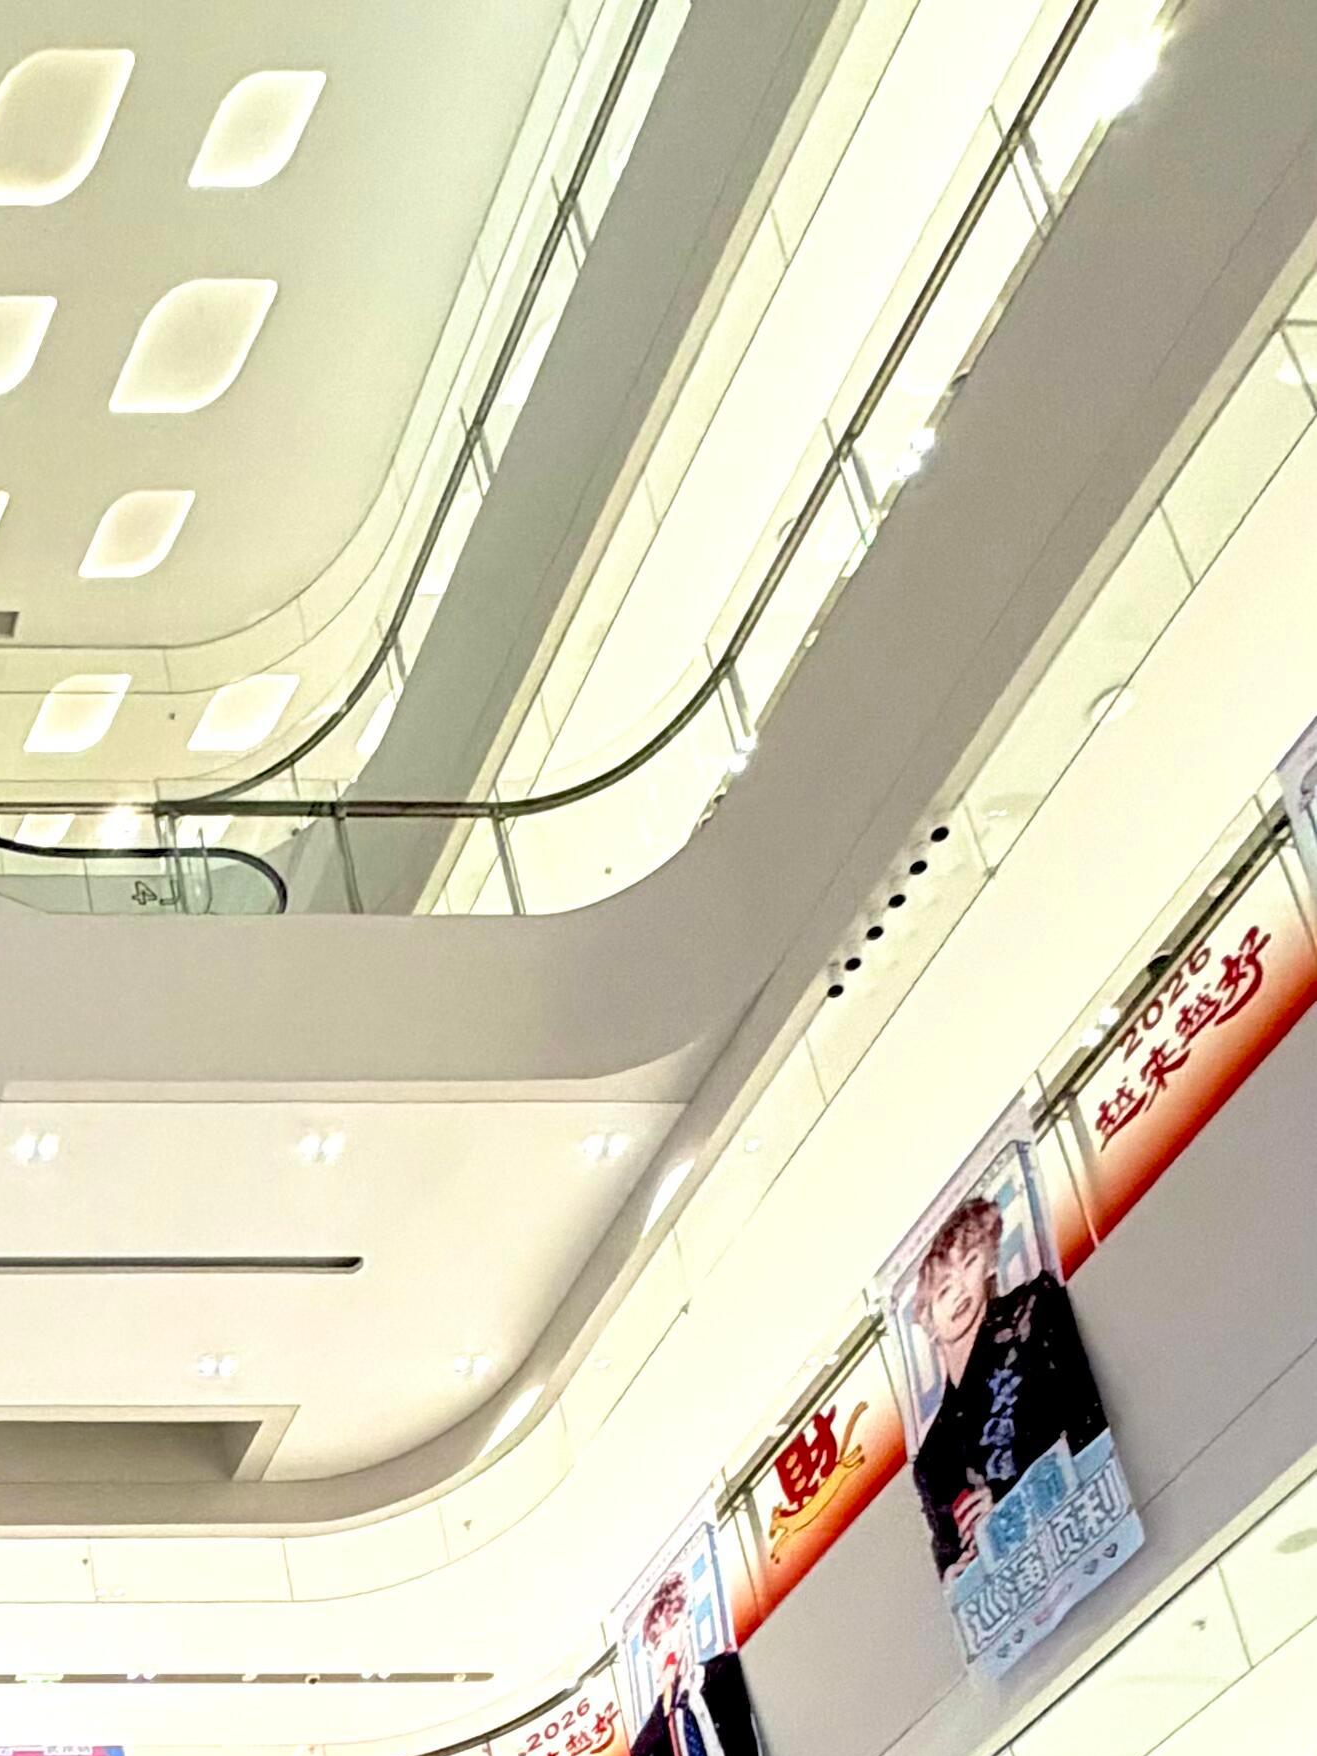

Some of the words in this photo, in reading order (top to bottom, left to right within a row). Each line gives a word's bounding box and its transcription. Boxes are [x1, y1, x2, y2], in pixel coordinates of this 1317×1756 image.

[1094, 924, 1272, 1153] 越来越好
[1118, 943, 1212, 1063] 2026
[958, 1460, 1128, 1652] 巡演顺利
[526, 1697, 591, 1753] 2026
